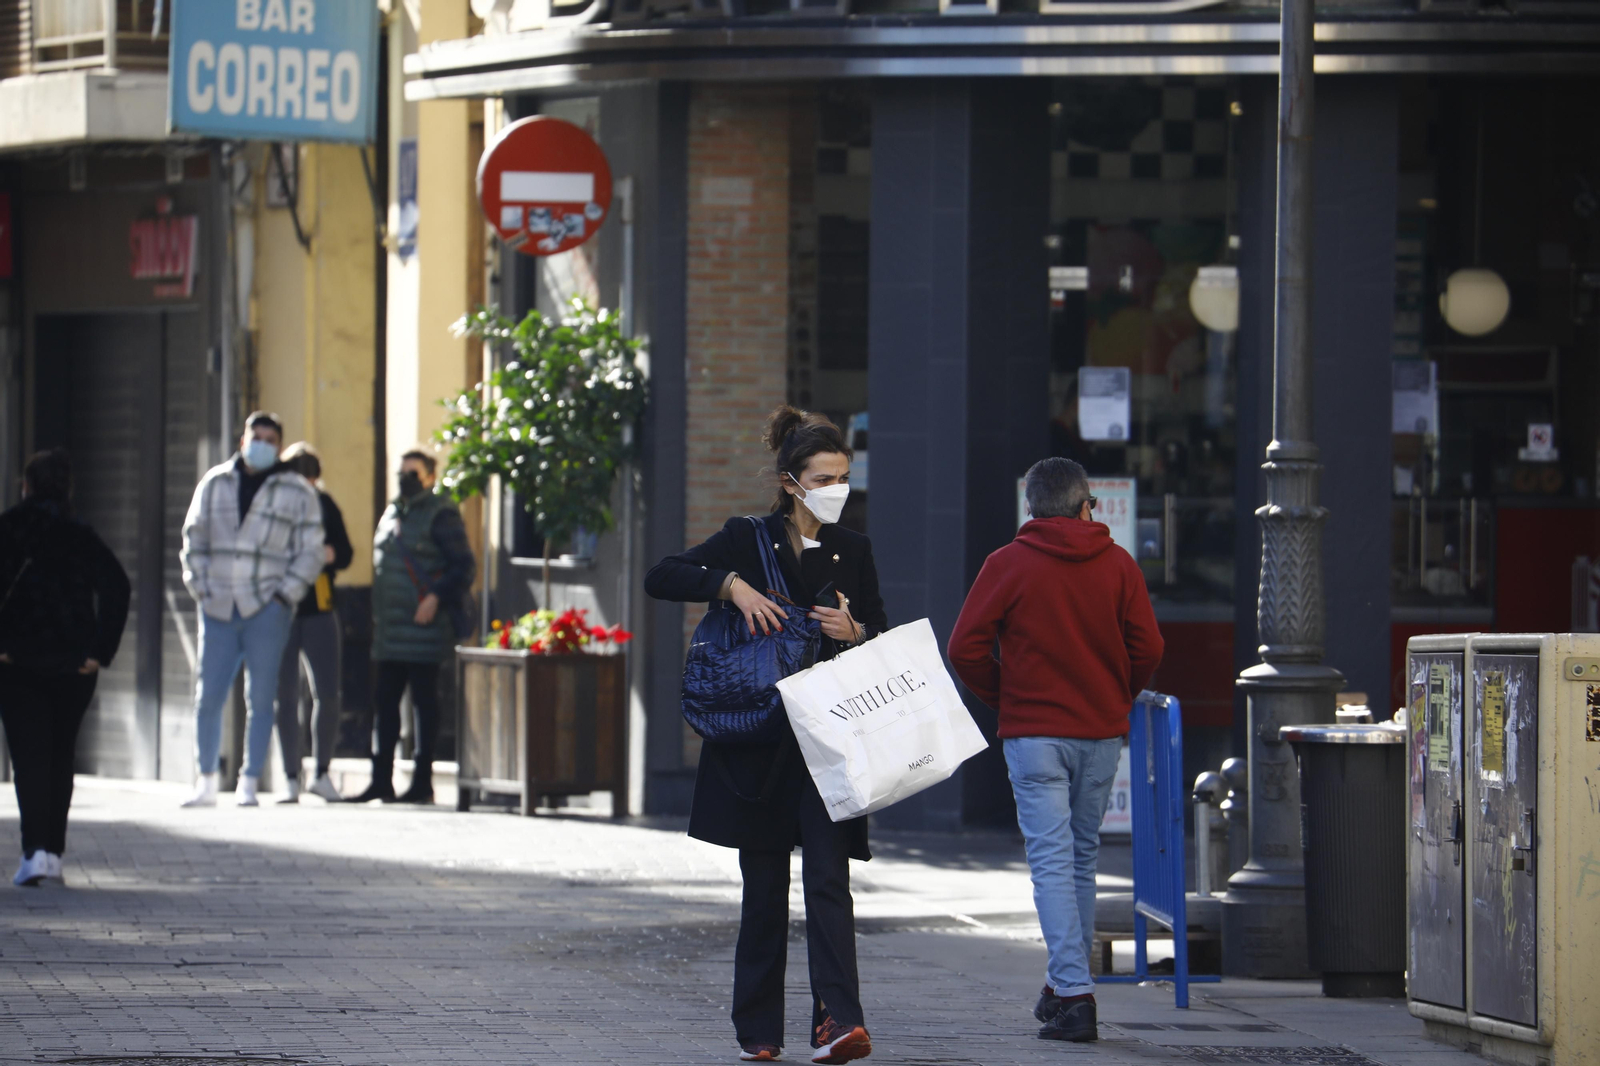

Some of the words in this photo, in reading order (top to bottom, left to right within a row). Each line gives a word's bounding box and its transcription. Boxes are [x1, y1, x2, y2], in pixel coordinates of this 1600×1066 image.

[236, 0, 315, 34] BAR
[188, 40, 361, 123] CORREO
[829, 690, 880, 722] WITH
[896, 709, 907, 718] TO
[908, 754, 934, 771] MANGO
